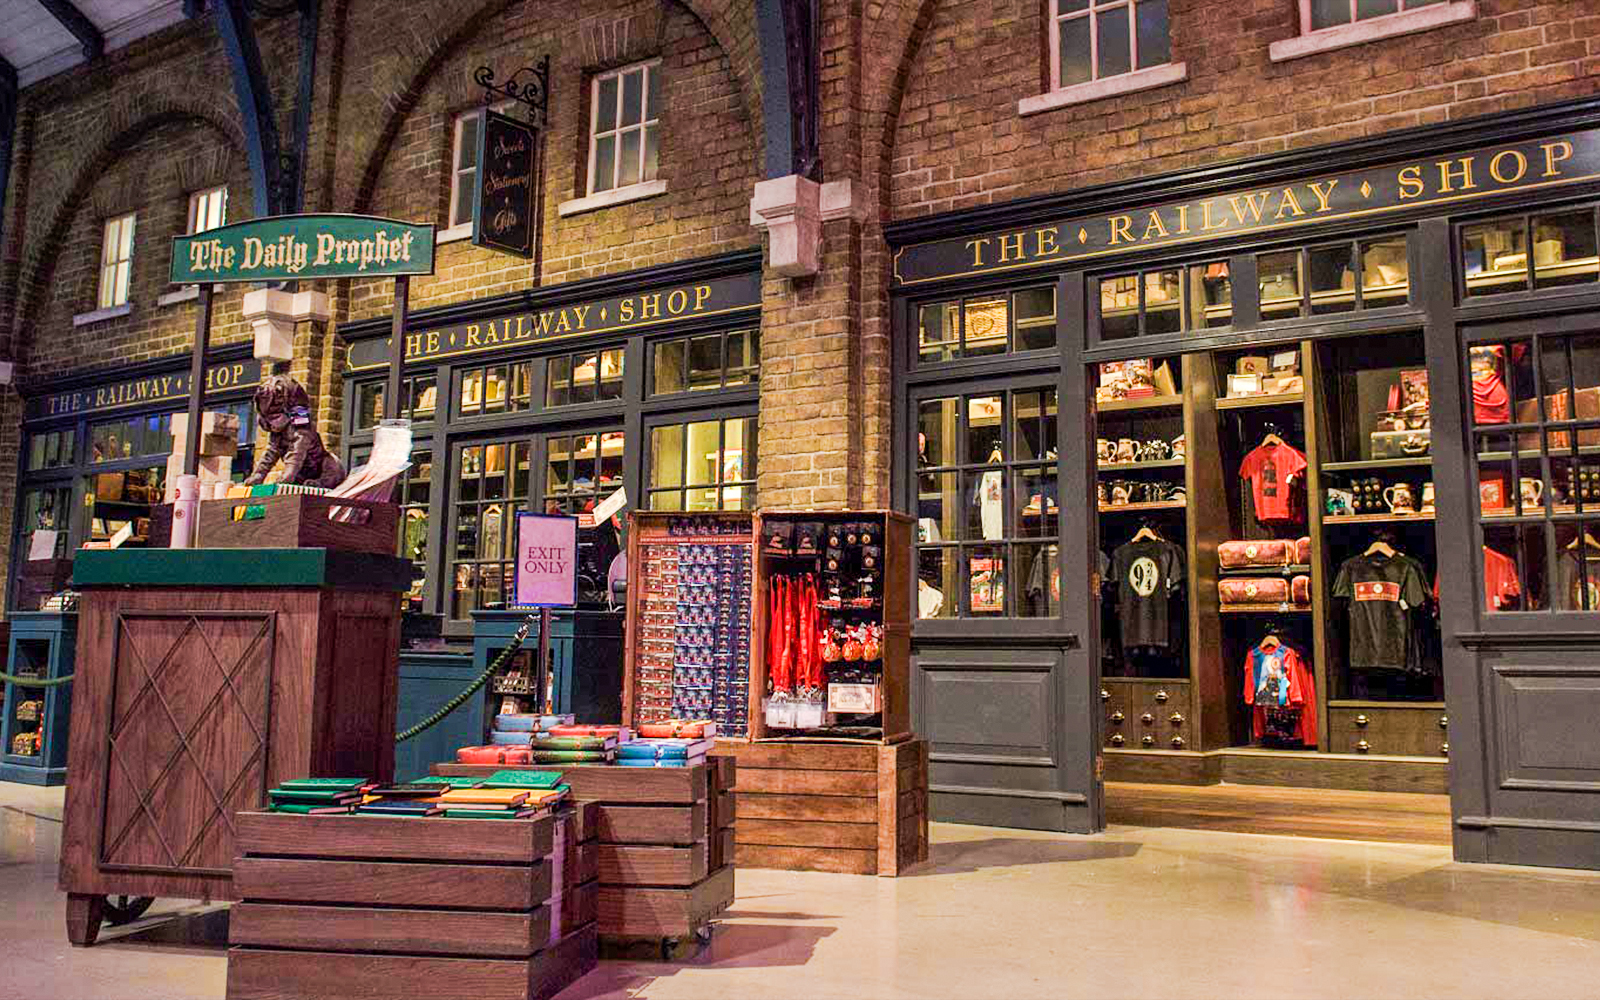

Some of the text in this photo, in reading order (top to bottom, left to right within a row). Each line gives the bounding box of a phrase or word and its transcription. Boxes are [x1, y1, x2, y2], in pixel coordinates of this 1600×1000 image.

[965, 141, 1574, 267] THE RAILWAY SHOP
[189, 230, 414, 273] The Daily Prophet
[386, 285, 712, 358] HE RAILWAY SHOP
[49, 393, 81, 414] THE
[95, 376, 172, 407] RAILWAY
[524, 560, 568, 574] ONLY
[527, 546, 566, 560] EXIT
